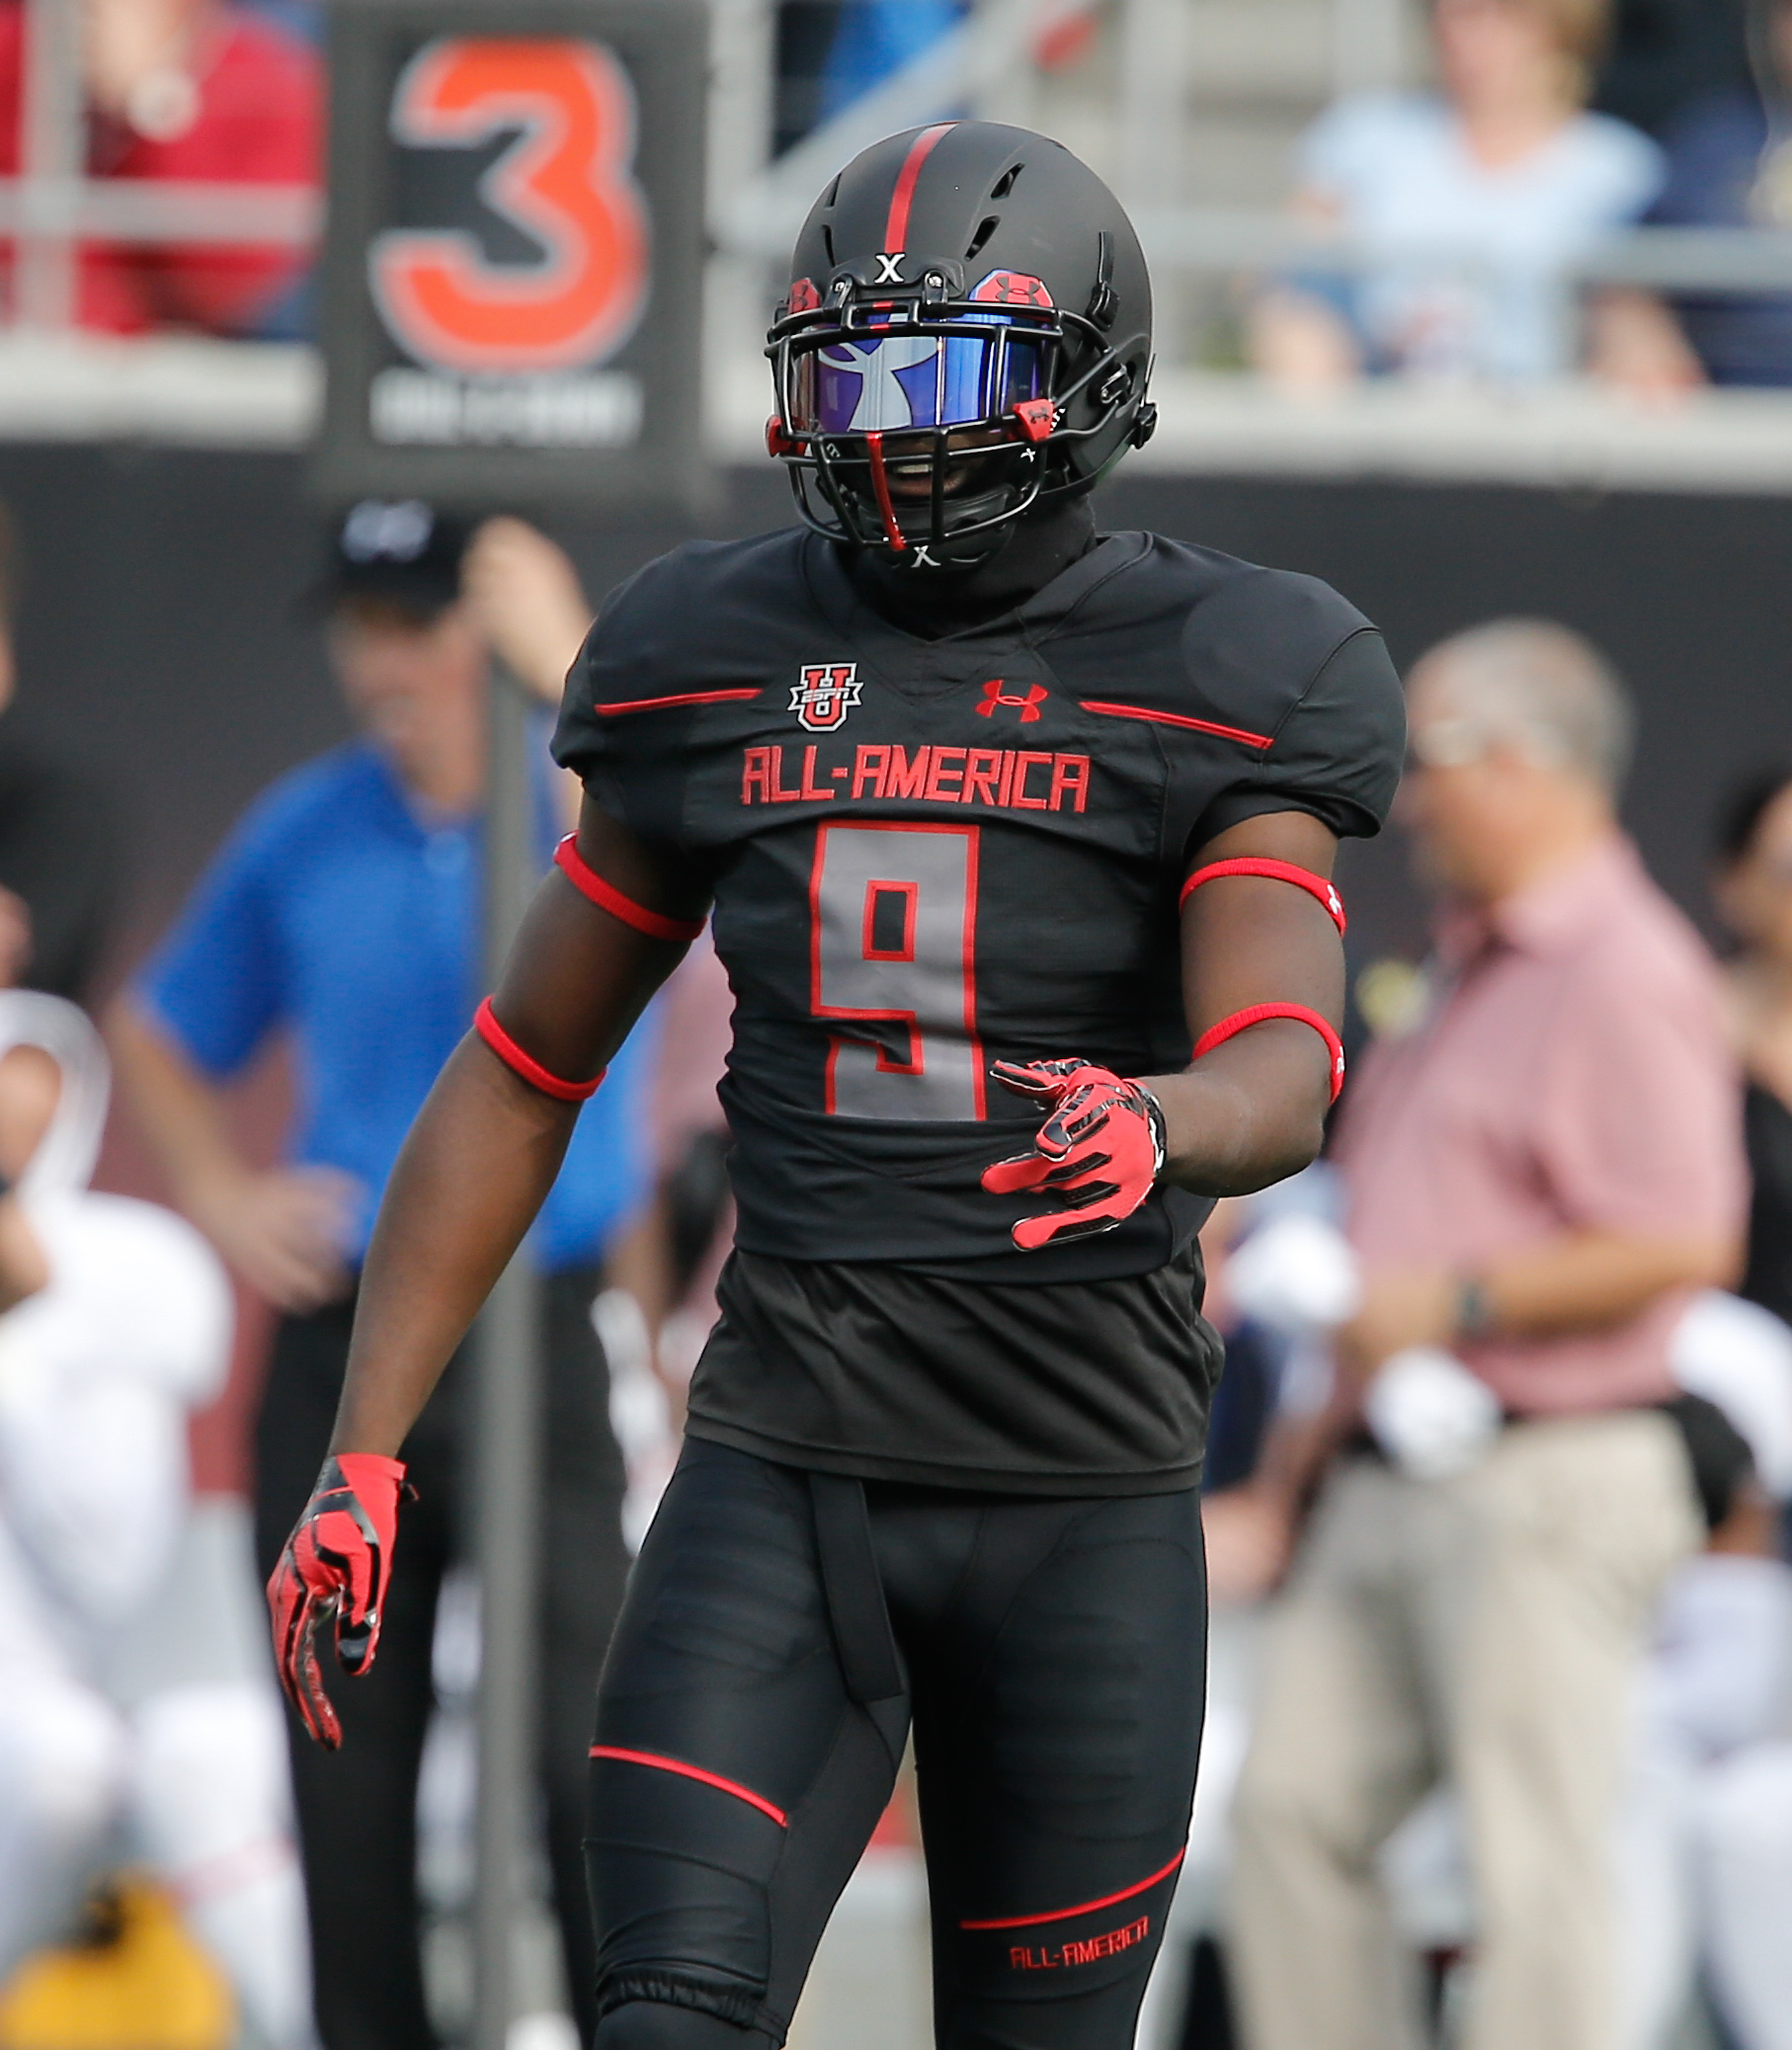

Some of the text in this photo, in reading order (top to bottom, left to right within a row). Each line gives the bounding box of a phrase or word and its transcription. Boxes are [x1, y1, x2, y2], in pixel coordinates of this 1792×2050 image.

[368, 34, 651, 373] 3
[874, 253, 906, 284] X
[801, 688, 851, 703] ESPN
[801, 665, 855, 729] U
[741, 745, 1090, 813] ALL-AMERICA
[809, 819, 987, 1121] 9
[1010, 1915, 1151, 1969] ALL-AMERICA
